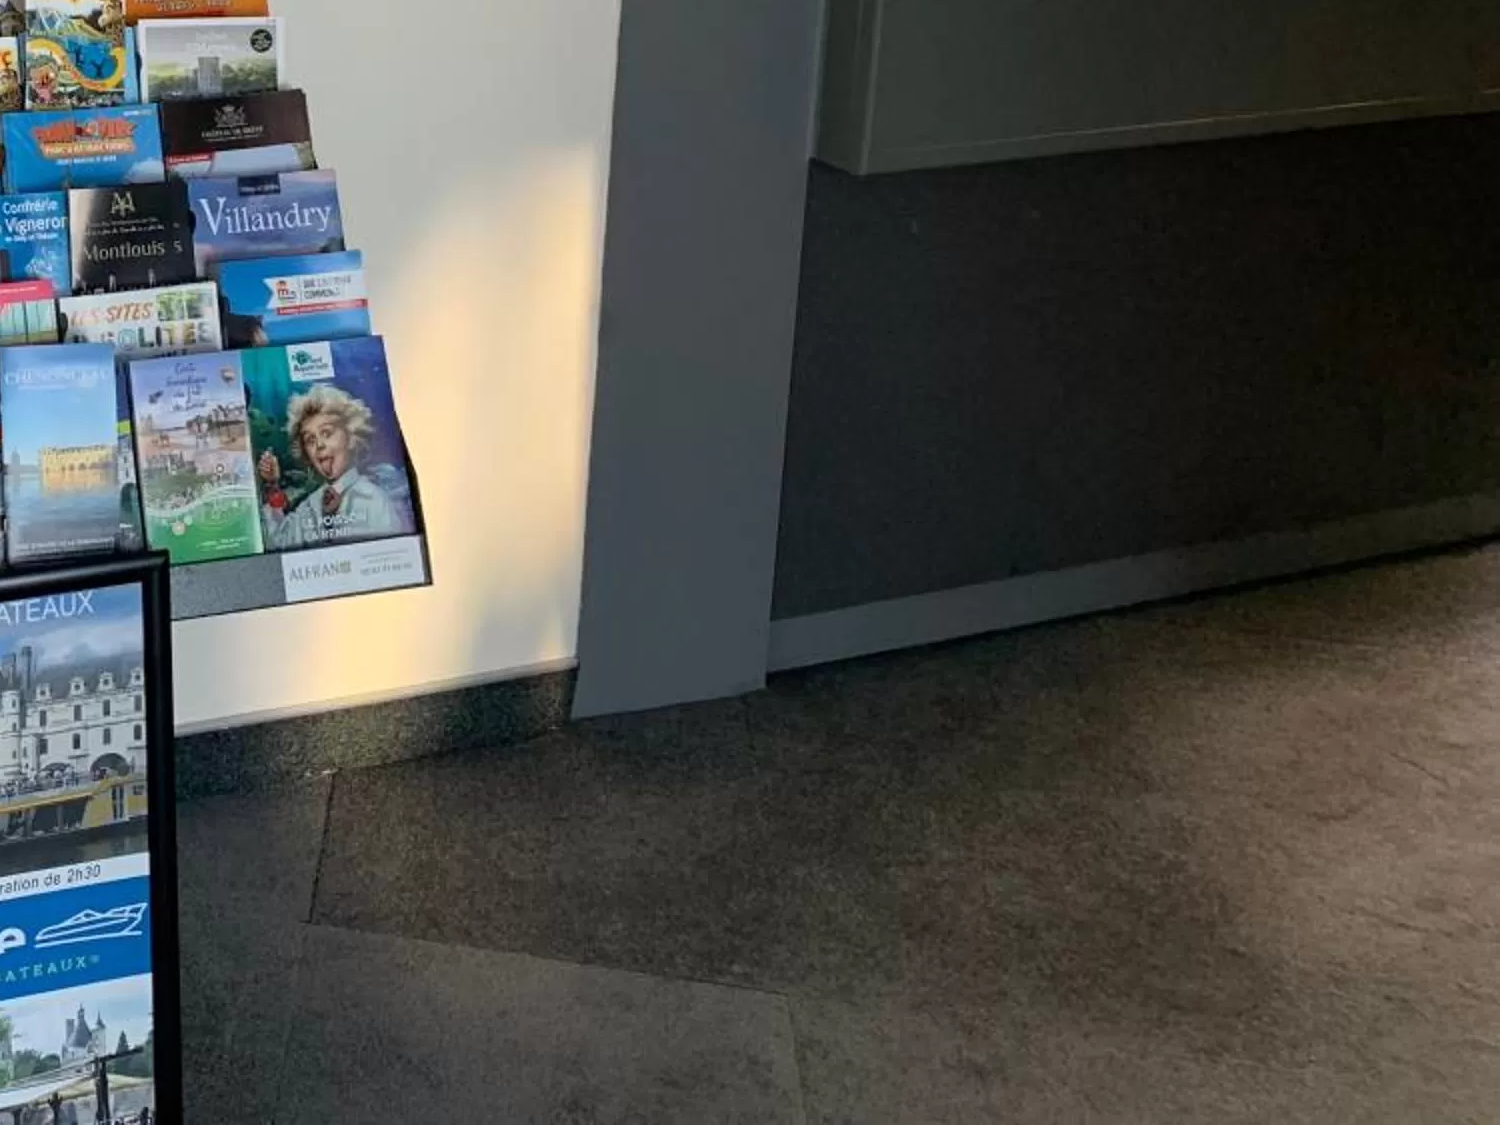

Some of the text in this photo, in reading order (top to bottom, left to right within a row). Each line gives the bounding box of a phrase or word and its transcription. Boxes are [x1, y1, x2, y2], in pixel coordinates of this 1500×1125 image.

[3, 200, 58, 215] Confrérie
[199, 195, 333, 236] Villandry
[84, 242, 165, 261] Montlouis
[106, 302, 153, 322] SITES
[43, 872, 62, 888] de
[67, 864, 100, 884] 2h30
